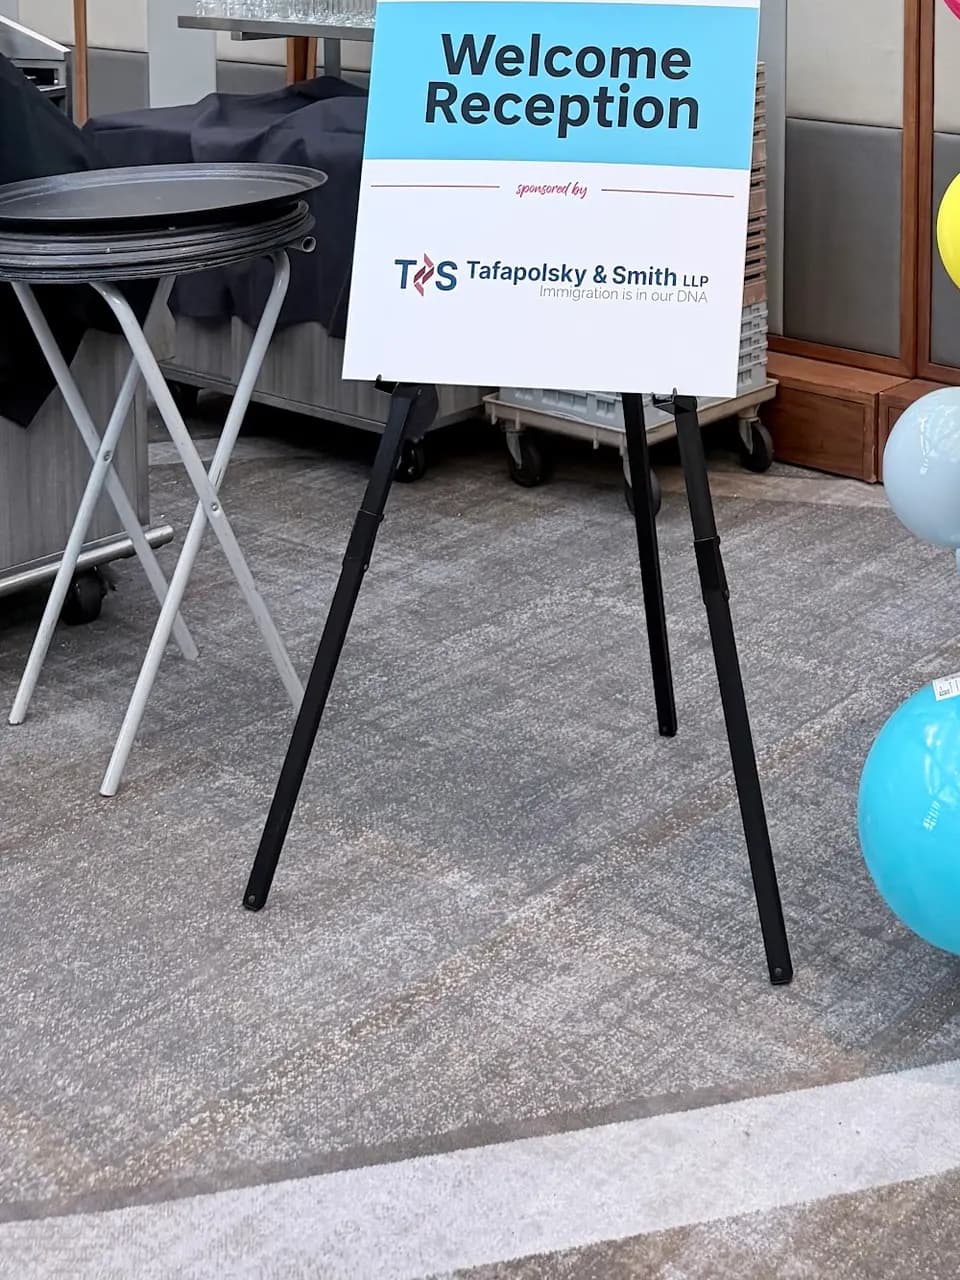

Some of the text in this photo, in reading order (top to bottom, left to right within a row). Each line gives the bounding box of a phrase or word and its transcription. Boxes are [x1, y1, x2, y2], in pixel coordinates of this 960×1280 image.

[441, 33, 691, 80] Welcome
[425, 82, 699, 139] Reception
[515, 181, 588, 200] sponsored by
[466, 260, 710, 288] Tafapolsky & Smith LLP
[539, 284, 708, 304] Immigration is in our DNA
